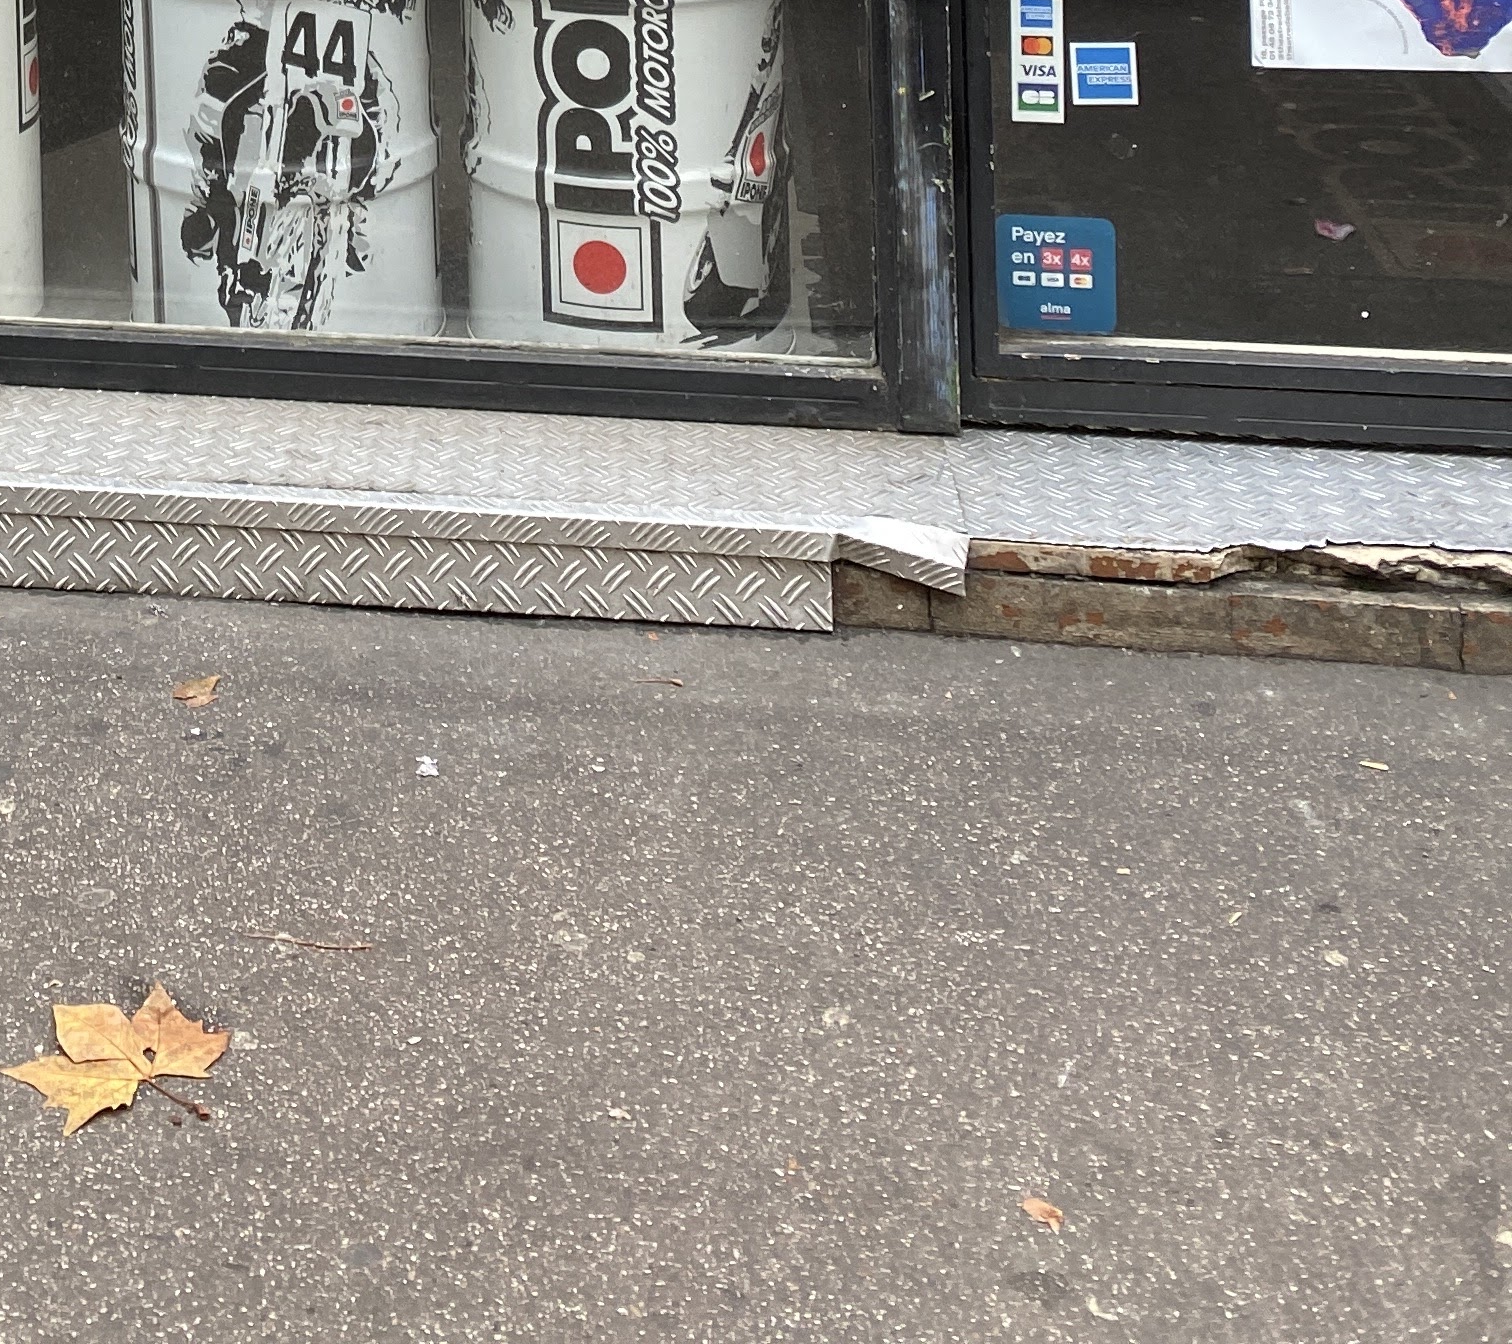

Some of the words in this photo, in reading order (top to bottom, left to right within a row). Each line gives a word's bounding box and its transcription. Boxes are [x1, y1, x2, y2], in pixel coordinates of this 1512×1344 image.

[281, 11, 357, 88] 44
[1021, 64, 1057, 77] VISA
[1078, 65, 1127, 73] AMERICAN
[1088, 76, 1132, 84] EXPRESS
[639, 129, 678, 220] 100%
[245, 187, 259, 234] IPONE
[1011, 226, 1066, 246] Payez
[1011, 251, 1035, 264] en
[1042, 252, 1062, 265] 3x
[1071, 254, 1090, 267] 4x
[1040, 303, 1071, 315] alma
